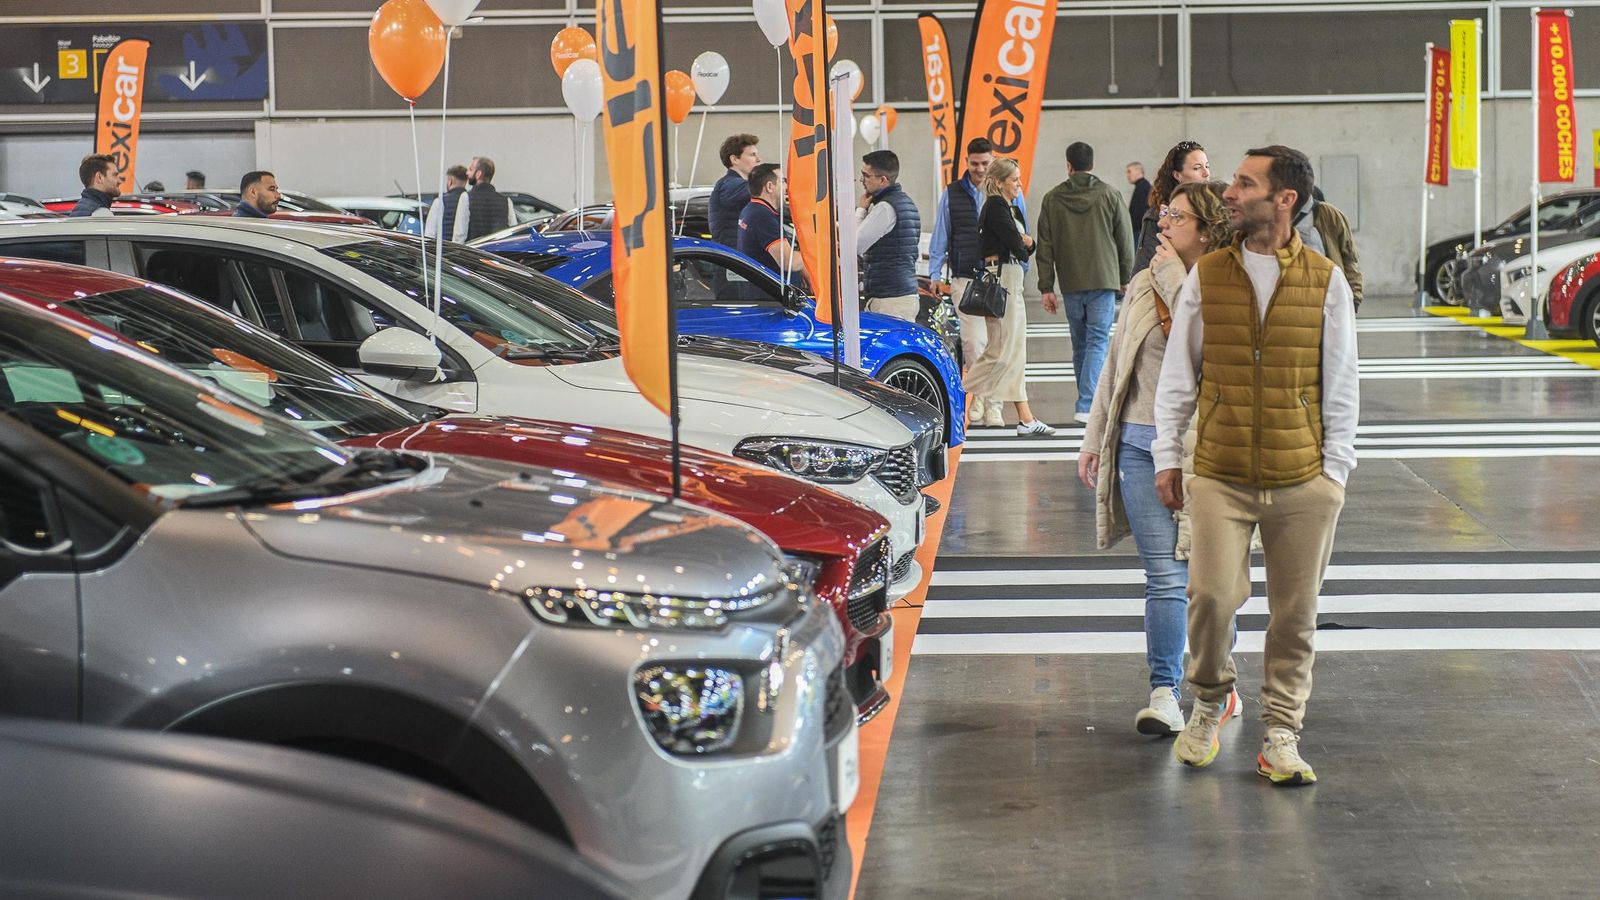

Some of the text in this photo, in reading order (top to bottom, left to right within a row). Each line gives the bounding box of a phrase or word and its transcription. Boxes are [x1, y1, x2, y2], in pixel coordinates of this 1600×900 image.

[66, 53, 79, 75] 3
[106, 55, 139, 182] exicar
[983, 0, 1047, 160] exica
[1550, 22, 1574, 179] +10.000 COCHES
